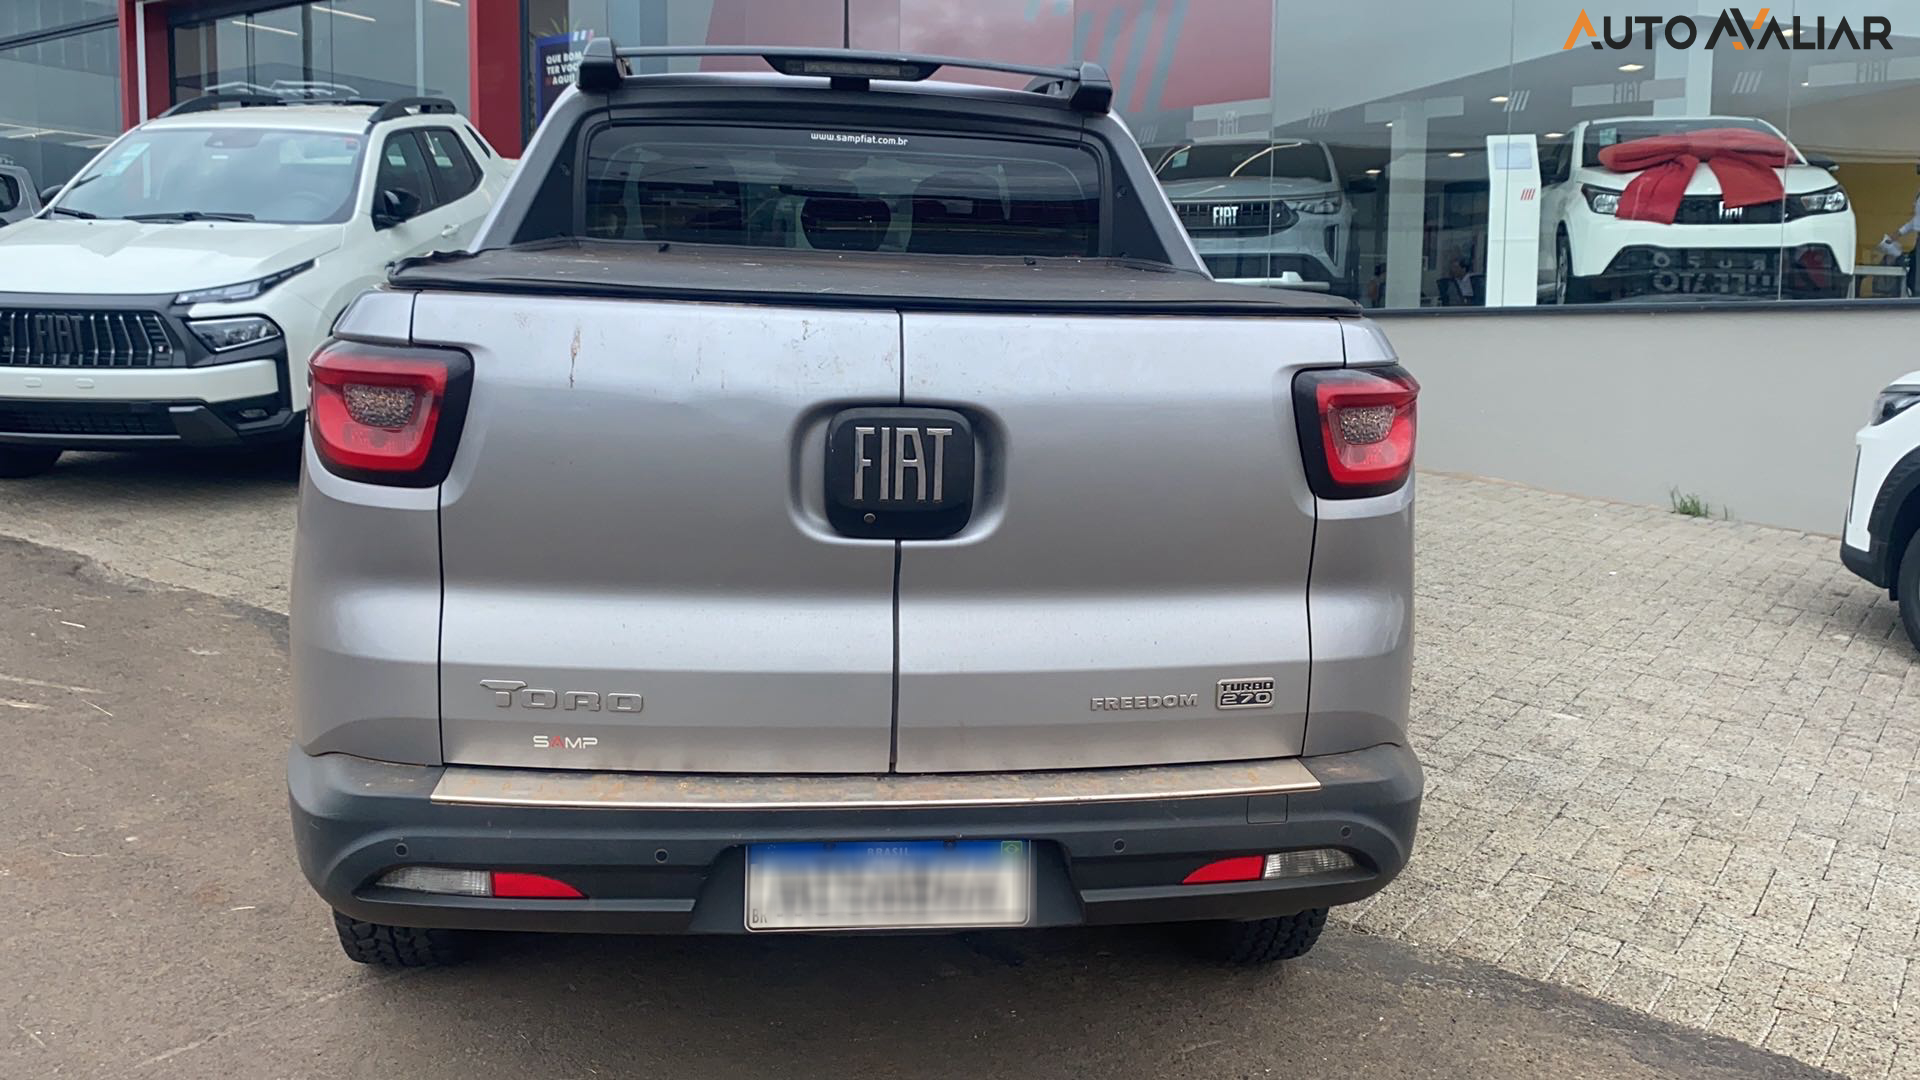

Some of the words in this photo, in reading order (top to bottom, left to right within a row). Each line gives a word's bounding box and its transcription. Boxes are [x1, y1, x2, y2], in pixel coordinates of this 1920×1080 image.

[546, 54, 562, 65] QUE
[562, 51, 582, 62] BOM
[546, 65, 560, 75] TER
[560, 63, 579, 72] VOC
[811, 132, 908, 146] www.sampfiat.com.br
[1213, 206, 1238, 226] FIAT
[35, 313, 84, 352] FIAT
[854, 426, 953, 502] FIAT
[1221, 682, 1274, 691] TURBO
[480, 679, 643, 713] TORO
[1091, 693, 1198, 711] FREEDOM
[1221, 692, 1273, 705] 270
[533, 736, 598, 749] SAMP
[867, 847, 910, 857] BRASIL
